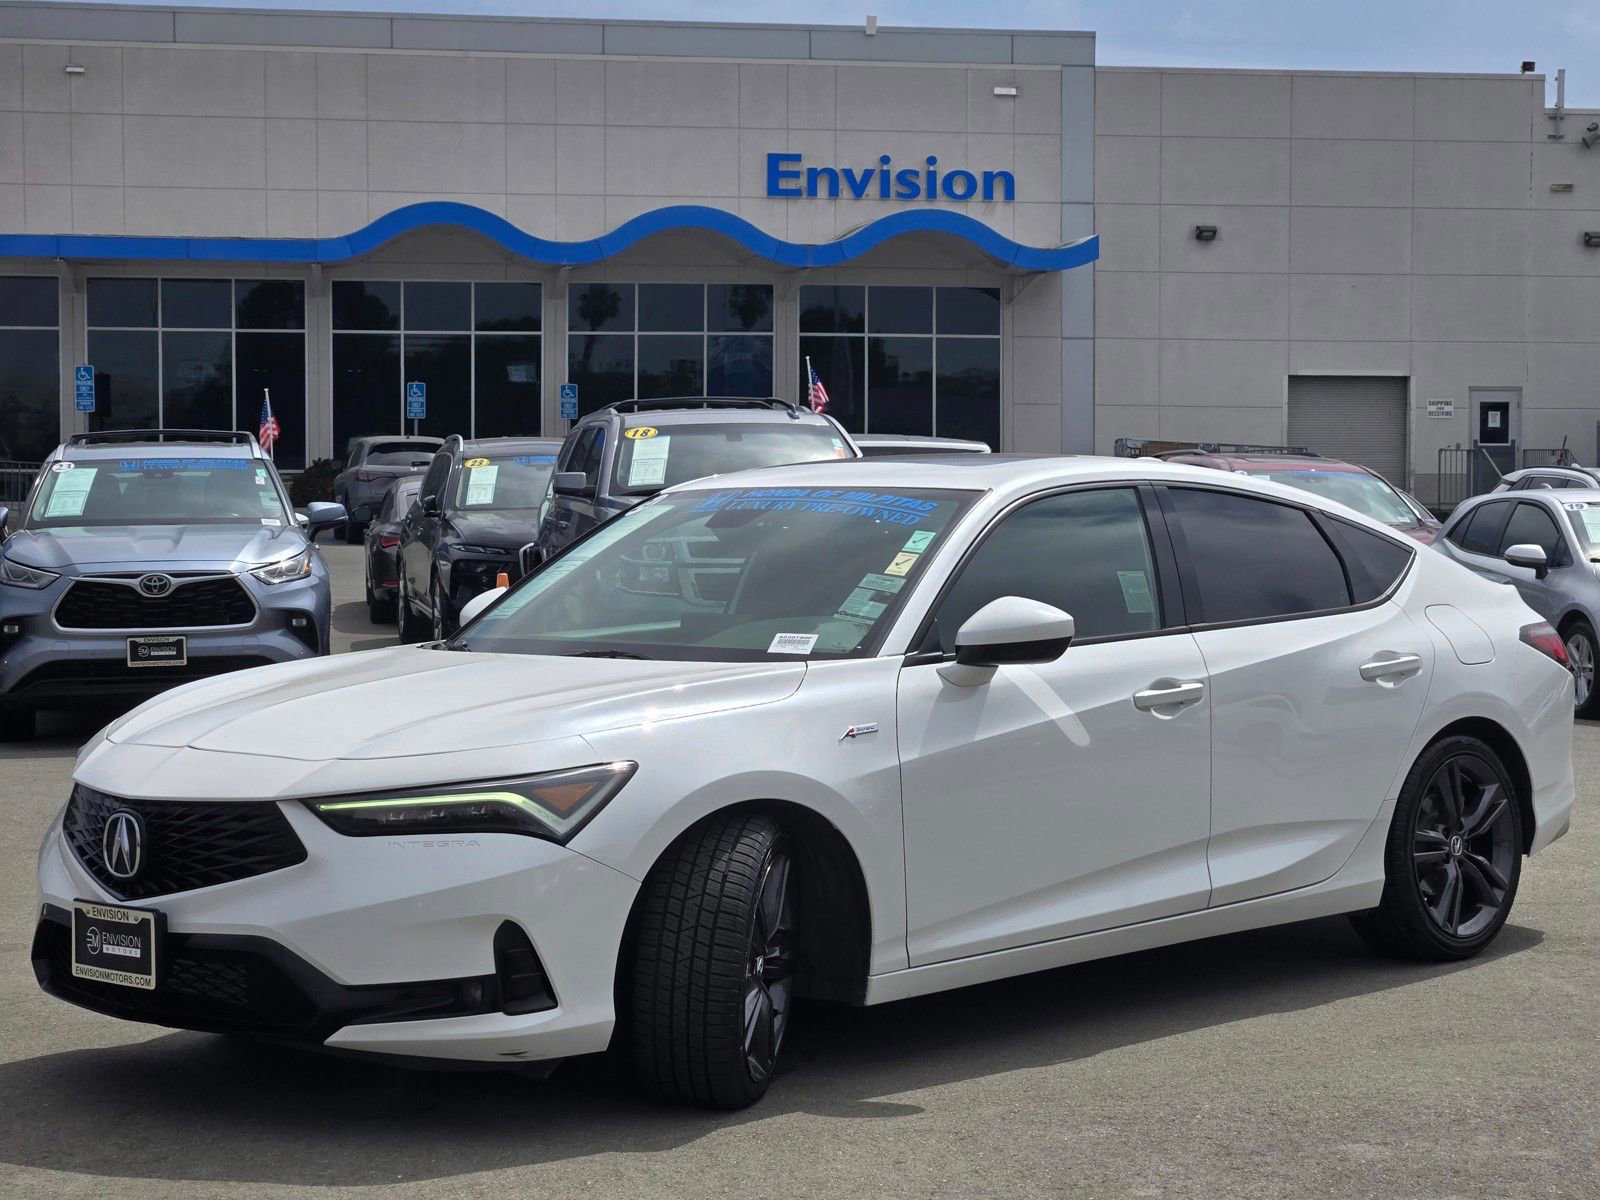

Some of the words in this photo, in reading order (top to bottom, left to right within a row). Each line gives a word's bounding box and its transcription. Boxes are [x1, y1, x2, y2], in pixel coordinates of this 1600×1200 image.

[767, 153, 1015, 202] Envision
[632, 428, 651, 437] 18
[55, 463, 72, 471] 23
[470, 459, 483, 467] 23
[725, 500, 797, 511] LUXURY
[741, 489, 811, 498] HONDA
[811, 489, 844, 498] OF
[840, 491, 938, 511] MILPITAS
[387, 840, 480, 848] INTEGRA
[91, 906, 130, 921] ENVISION
[102, 932, 141, 948] ENVISION
[105, 947, 139, 956] MOTORS
[75, 966, 152, 987] ENVISIONMOTORS.COM
